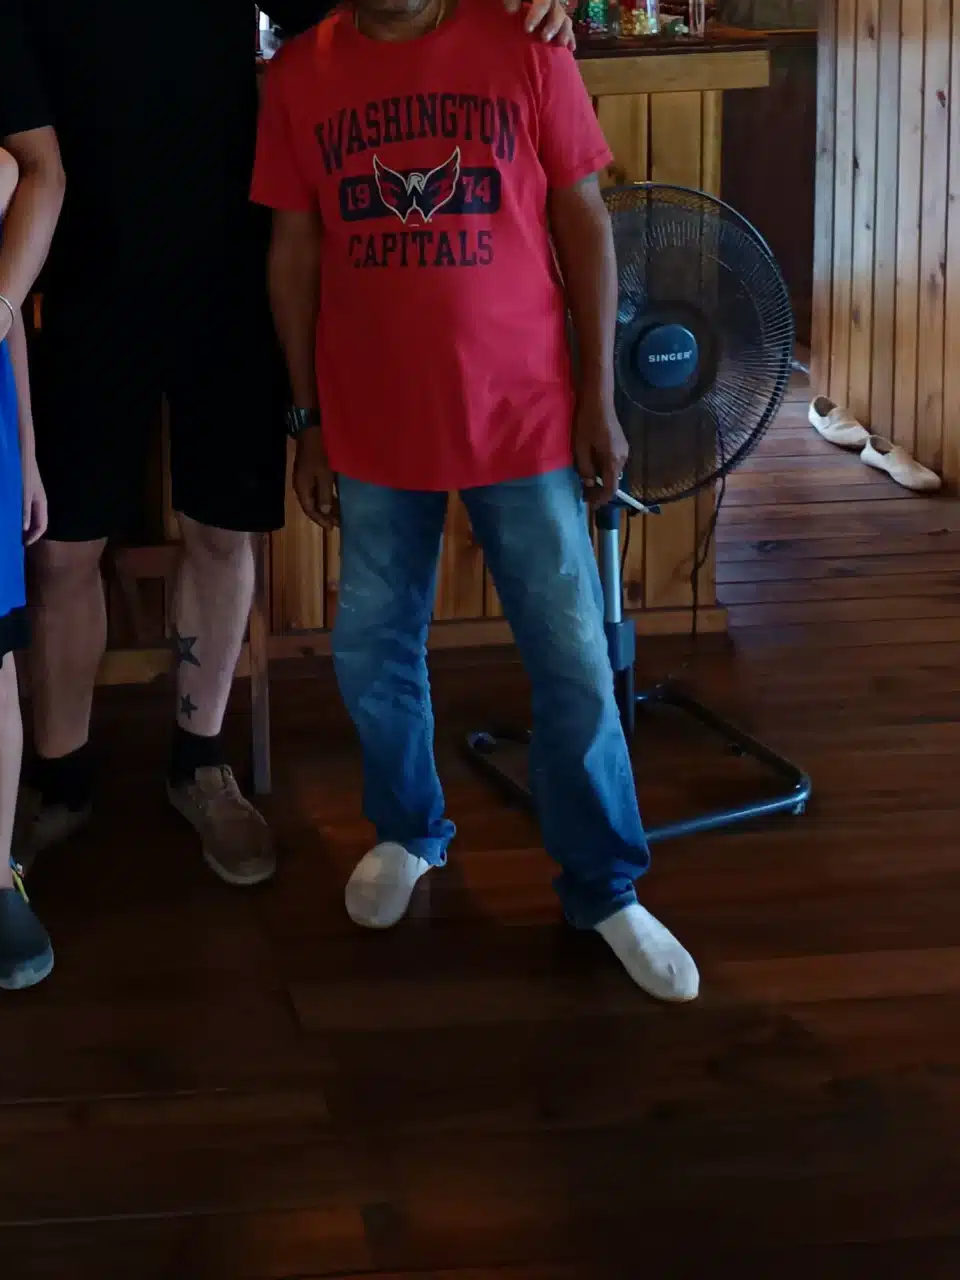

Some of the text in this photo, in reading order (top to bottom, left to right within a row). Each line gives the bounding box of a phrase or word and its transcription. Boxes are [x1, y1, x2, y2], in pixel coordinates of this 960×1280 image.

[313, 93, 521, 176] WASHINGTON
[345, 174, 491, 211] 19 74
[348, 230, 494, 269] CAPITALS
[647, 351, 691, 363] SINGER
